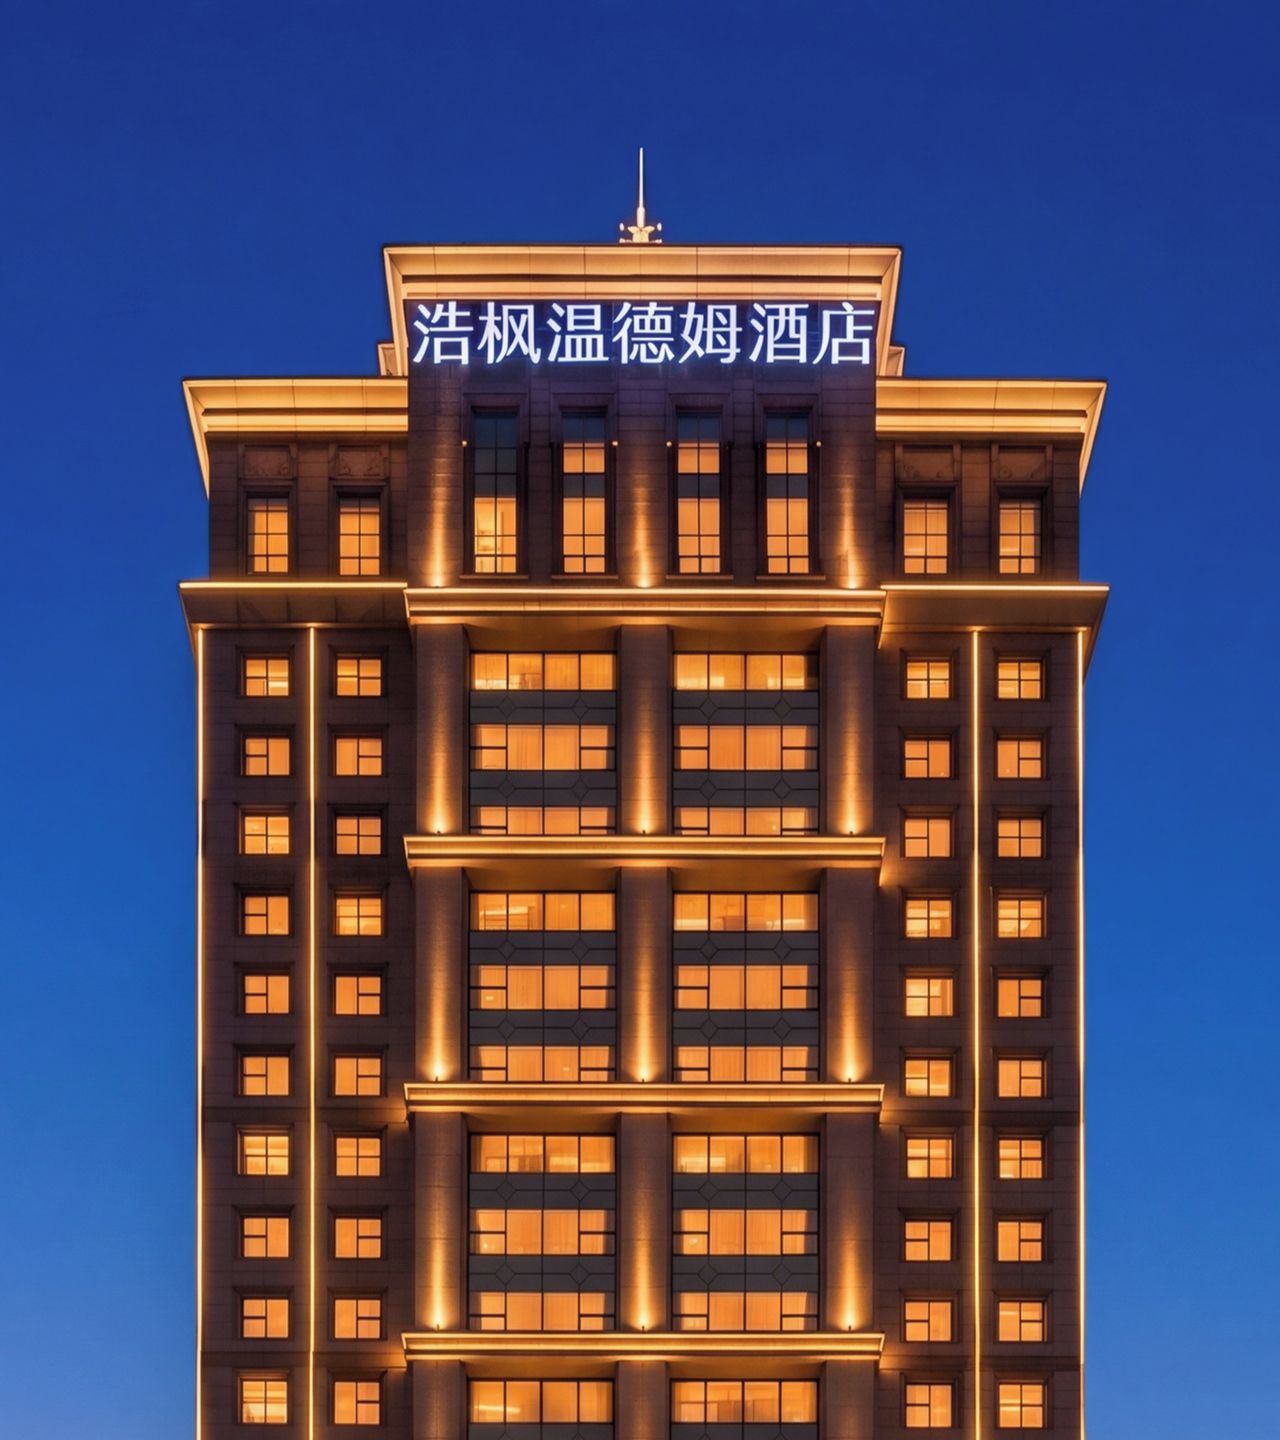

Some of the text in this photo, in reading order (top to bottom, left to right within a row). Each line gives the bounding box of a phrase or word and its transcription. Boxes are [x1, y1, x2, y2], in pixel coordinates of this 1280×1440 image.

[412, 300, 875, 365] 浩枫温德姆酒店
